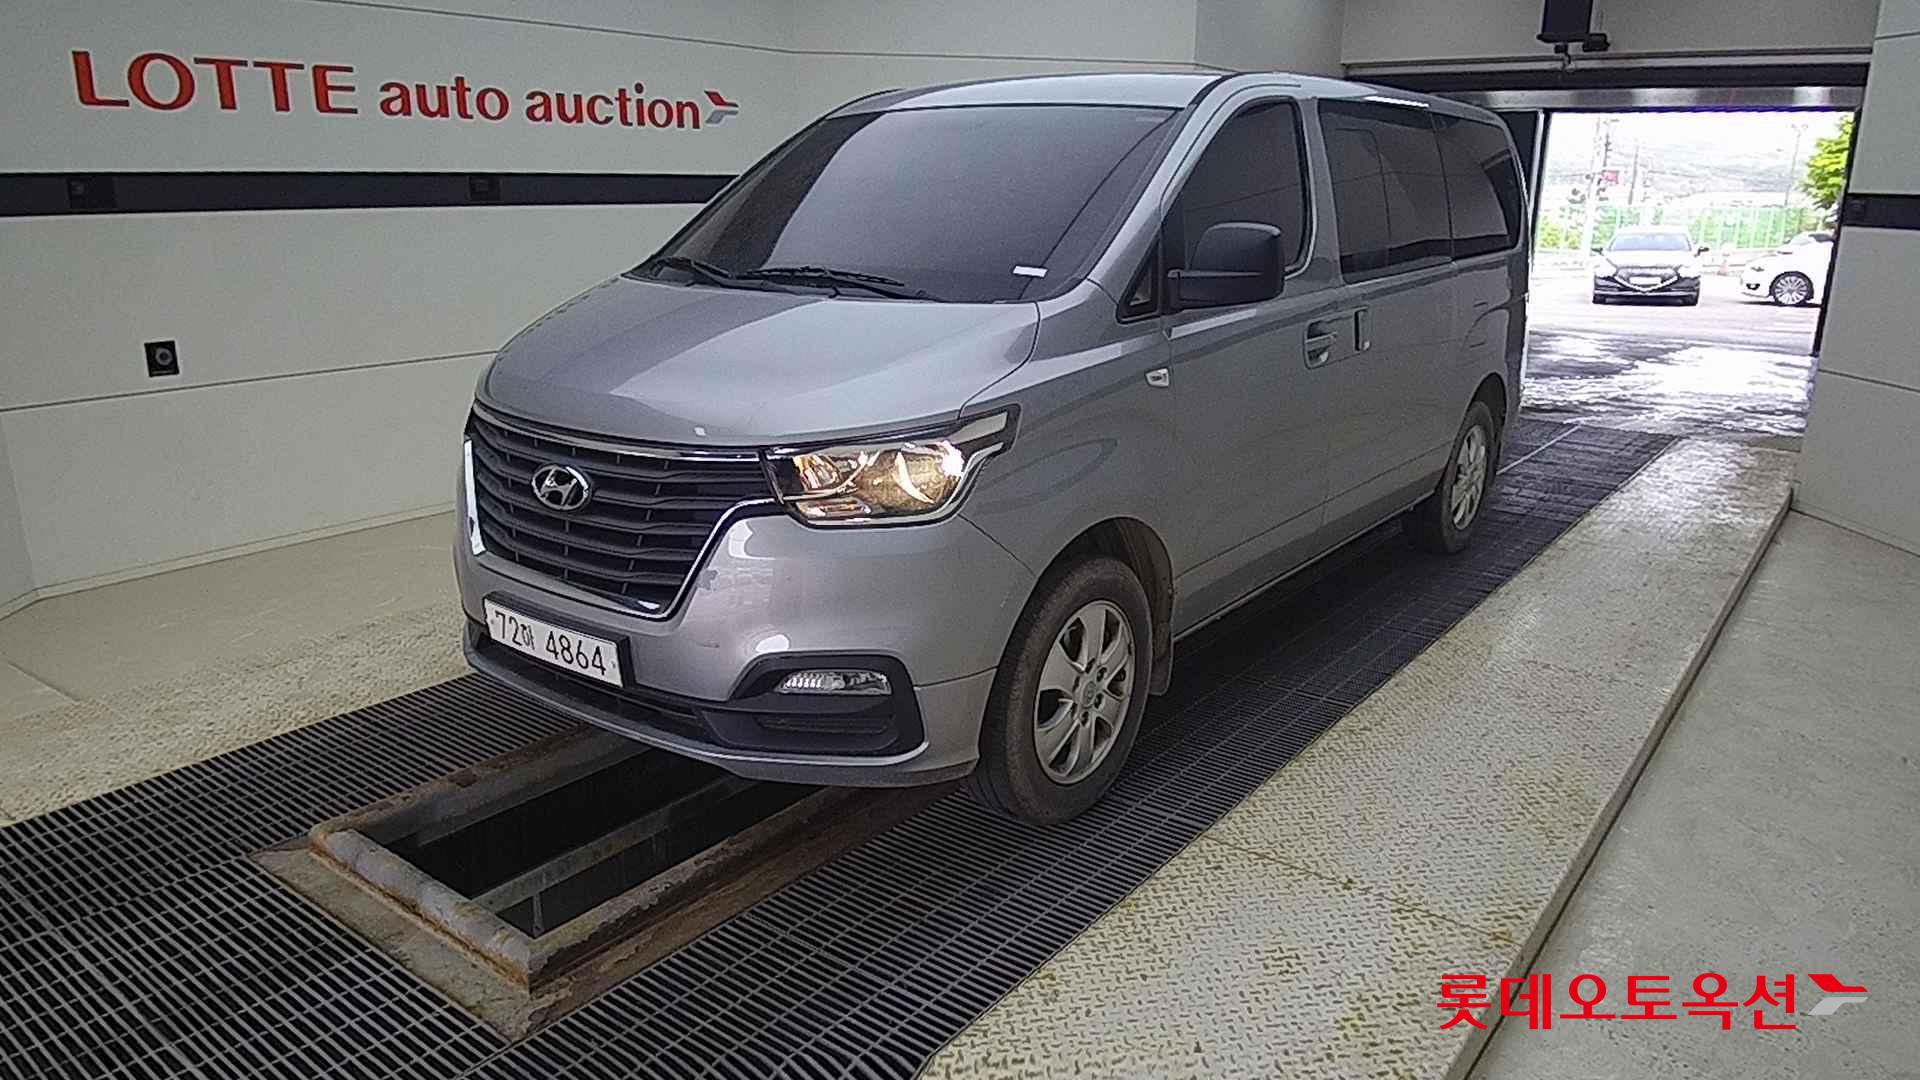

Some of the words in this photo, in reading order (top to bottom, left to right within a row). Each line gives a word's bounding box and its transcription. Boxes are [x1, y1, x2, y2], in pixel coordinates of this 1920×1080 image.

[72, 50, 358, 115] LOTTE
[378, 76, 510, 121] auto
[525, 83, 701, 130] auction
[545, 630, 607, 676] 4864
